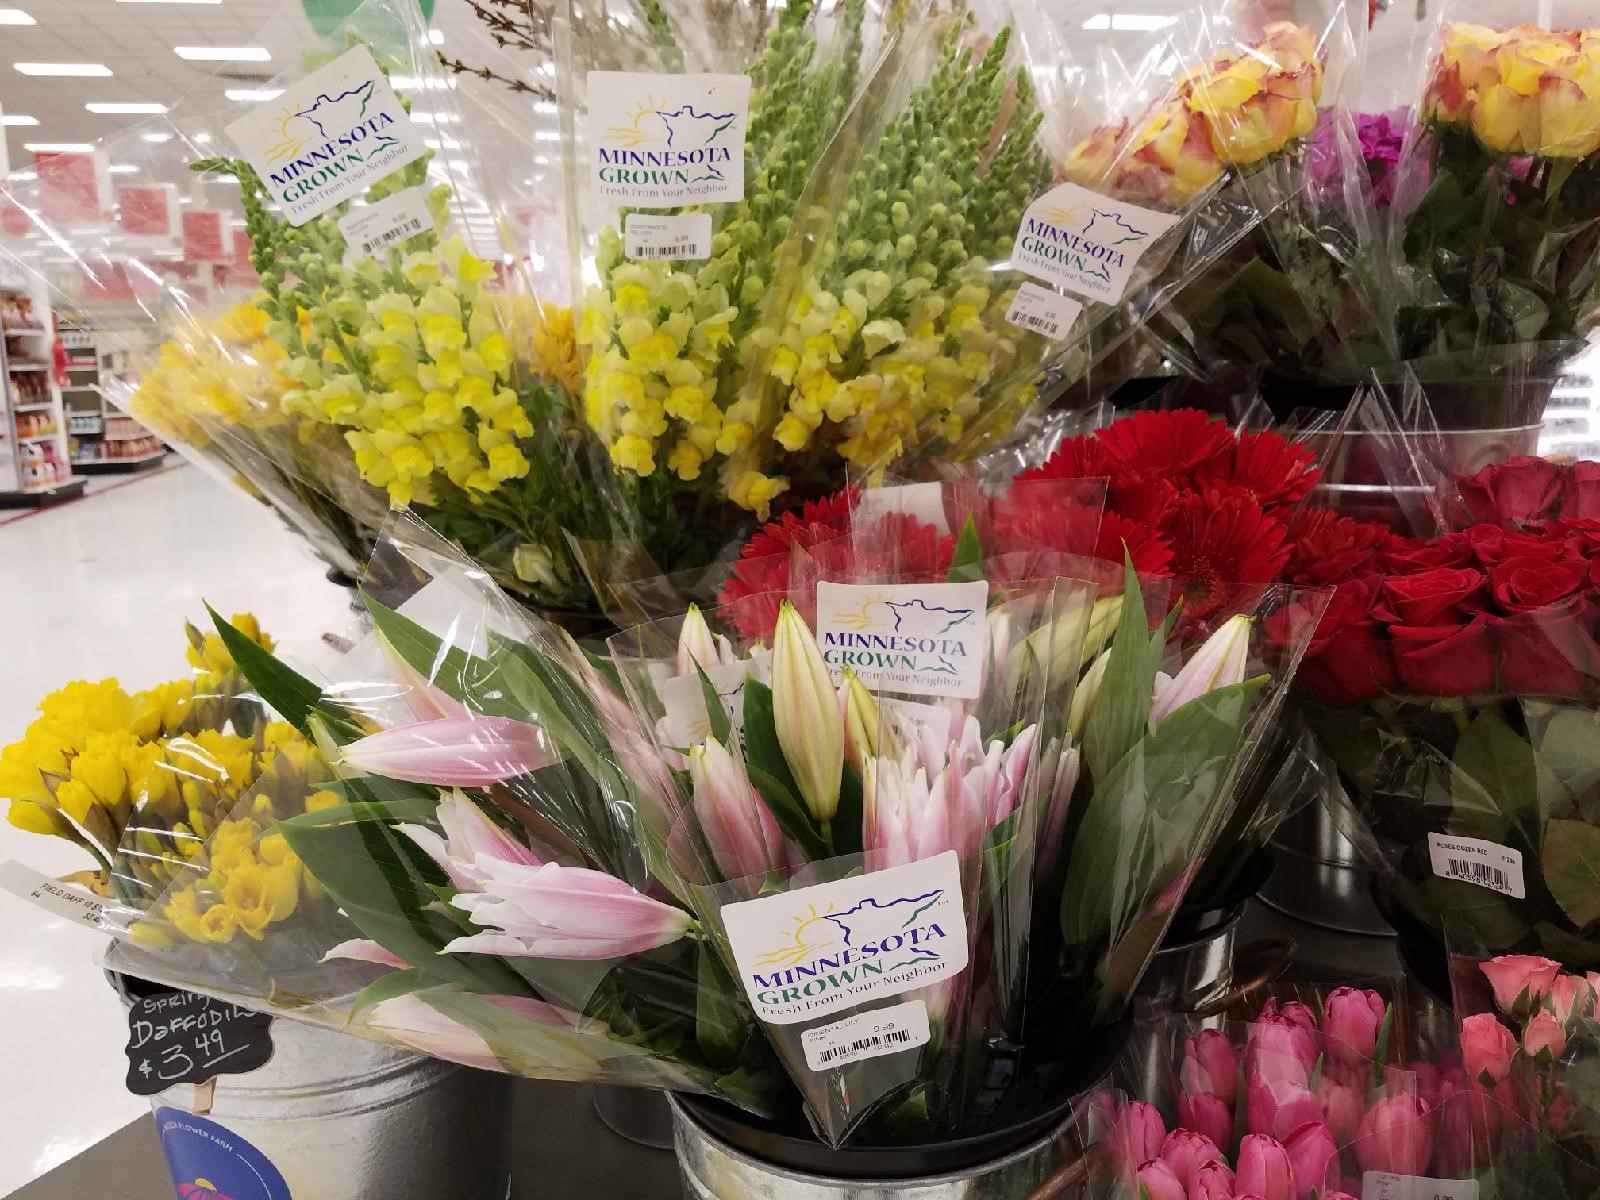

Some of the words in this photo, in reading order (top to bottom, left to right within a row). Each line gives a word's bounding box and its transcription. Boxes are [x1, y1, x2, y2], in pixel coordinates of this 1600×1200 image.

[269, 111, 395, 188] MINNESOTA
[598, 147, 731, 167] MINNESOTA
[282, 148, 364, 203] GROWN
[291, 194, 319, 215] Fresh
[318, 180, 345, 201] From
[344, 168, 368, 187] Your
[367, 144, 410, 172] Neighbor
[598, 167, 689, 184] GROWN
[600, 185, 629, 196] Fresh
[632, 186, 660, 198] From
[661, 187, 684, 198] Your
[685, 183, 730, 196] Neighbor
[1021, 236, 1087, 271] GROWN
[1025, 218, 1125, 268] MINNESOTA
[1018, 252, 1040, 266] Fresh
[1040, 259, 1061, 273] From
[1078, 272, 1112, 294] Neighbor
[823, 649, 917, 671] GROWN
[824, 632, 968, 657] MINNESOTA
[855, 669, 884, 680] From
[886, 672, 910, 683] Your
[912, 674, 964, 687] Neighbor
[752, 923, 948, 989] MINNESOTA
[757, 959, 885, 1006] GROWN
[762, 1003, 803, 1016] Fresh
[805, 992, 845, 1011] From
[845, 980, 881, 996] Your
[882, 960, 950, 987] Neighbor
